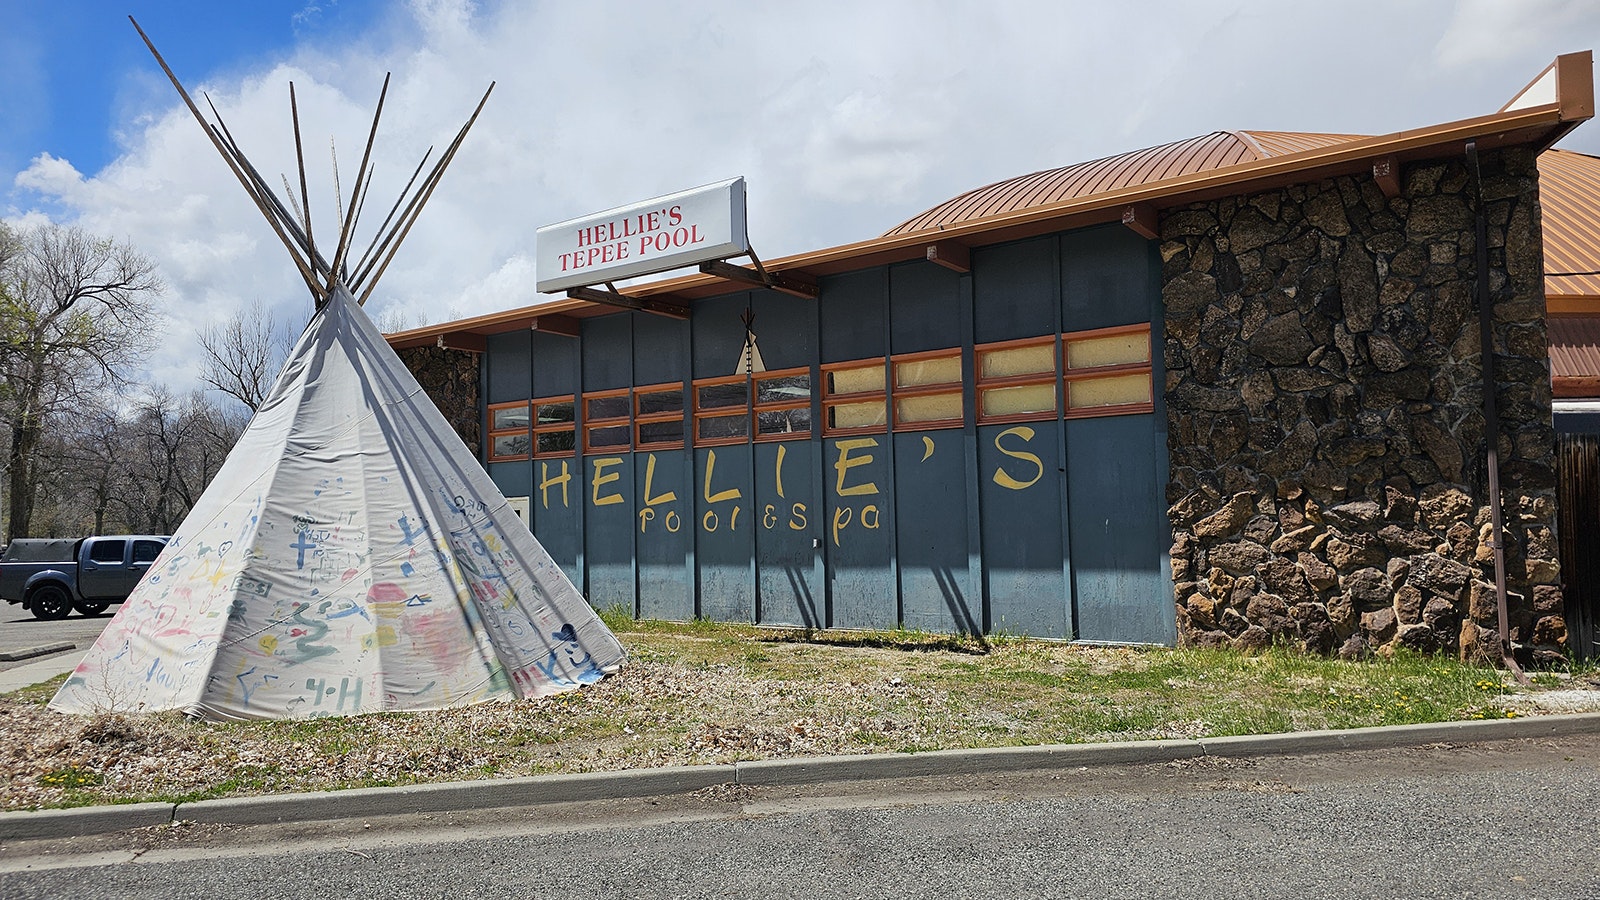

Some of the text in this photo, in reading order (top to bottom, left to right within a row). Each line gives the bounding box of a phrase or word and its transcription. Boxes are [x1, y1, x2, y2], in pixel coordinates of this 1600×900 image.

[558, 224, 705, 272] TEPEE POOL
[577, 205, 683, 247] HELLIE'S
[539, 426, 1044, 510] HELLIE'S
